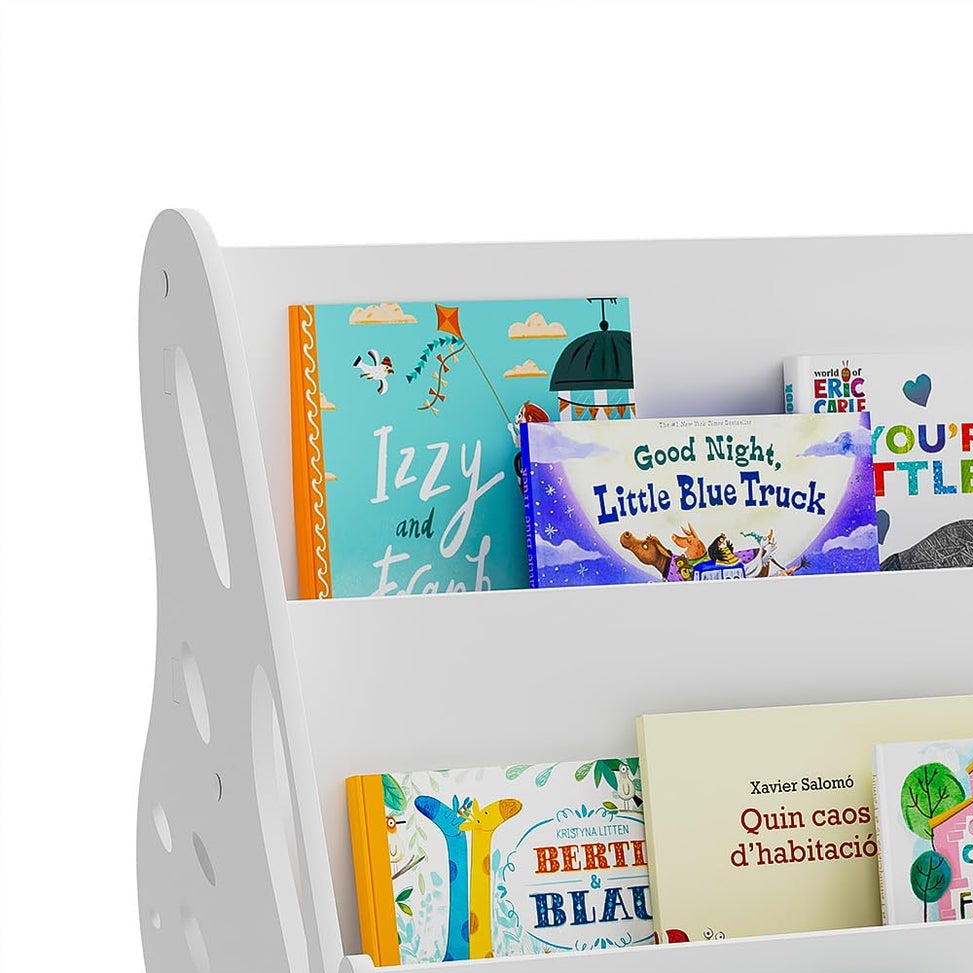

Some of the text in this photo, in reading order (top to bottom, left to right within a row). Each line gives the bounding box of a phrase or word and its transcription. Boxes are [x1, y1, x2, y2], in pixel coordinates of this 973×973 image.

[814, 367, 863, 377] world of
[633, 435, 783, 472] Good Night,
[369, 425, 505, 559] Izzy
[593, 471, 827, 525] Little Blue Truck
[396, 507, 435, 540] and
[750, 773, 854, 796] Xavier Salomó
[556, 824, 630, 839] KRISTYNA LITTEN
[740, 805, 872, 835] Quin caos
[533, 840, 648, 875] BERTI
[590, 874, 602, 889] &
